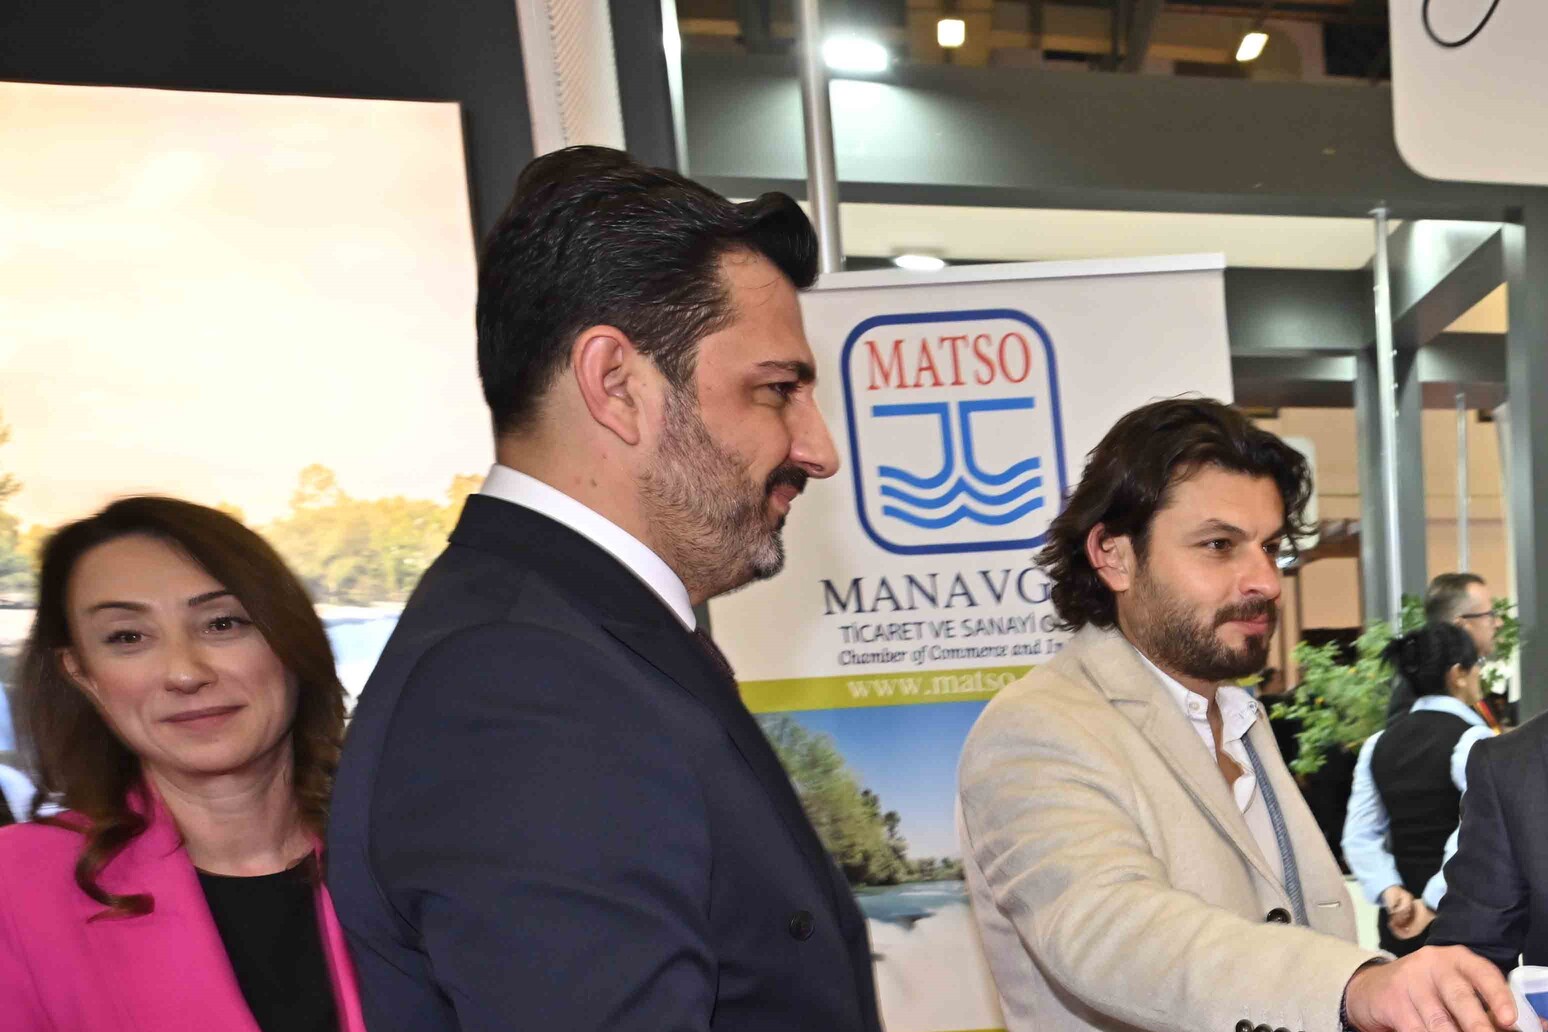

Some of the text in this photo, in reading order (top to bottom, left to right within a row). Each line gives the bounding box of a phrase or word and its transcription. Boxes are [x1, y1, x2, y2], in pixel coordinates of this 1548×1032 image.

[864, 331, 1032, 390] MATSO
[838, 621, 925, 644] TİCARET
[928, 619, 956, 639] VE
[960, 611, 1036, 638] SANAYİ
[838, 646, 906, 667] Chamber
[911, 644, 927, 666] of
[1012, 638, 1042, 657] and
